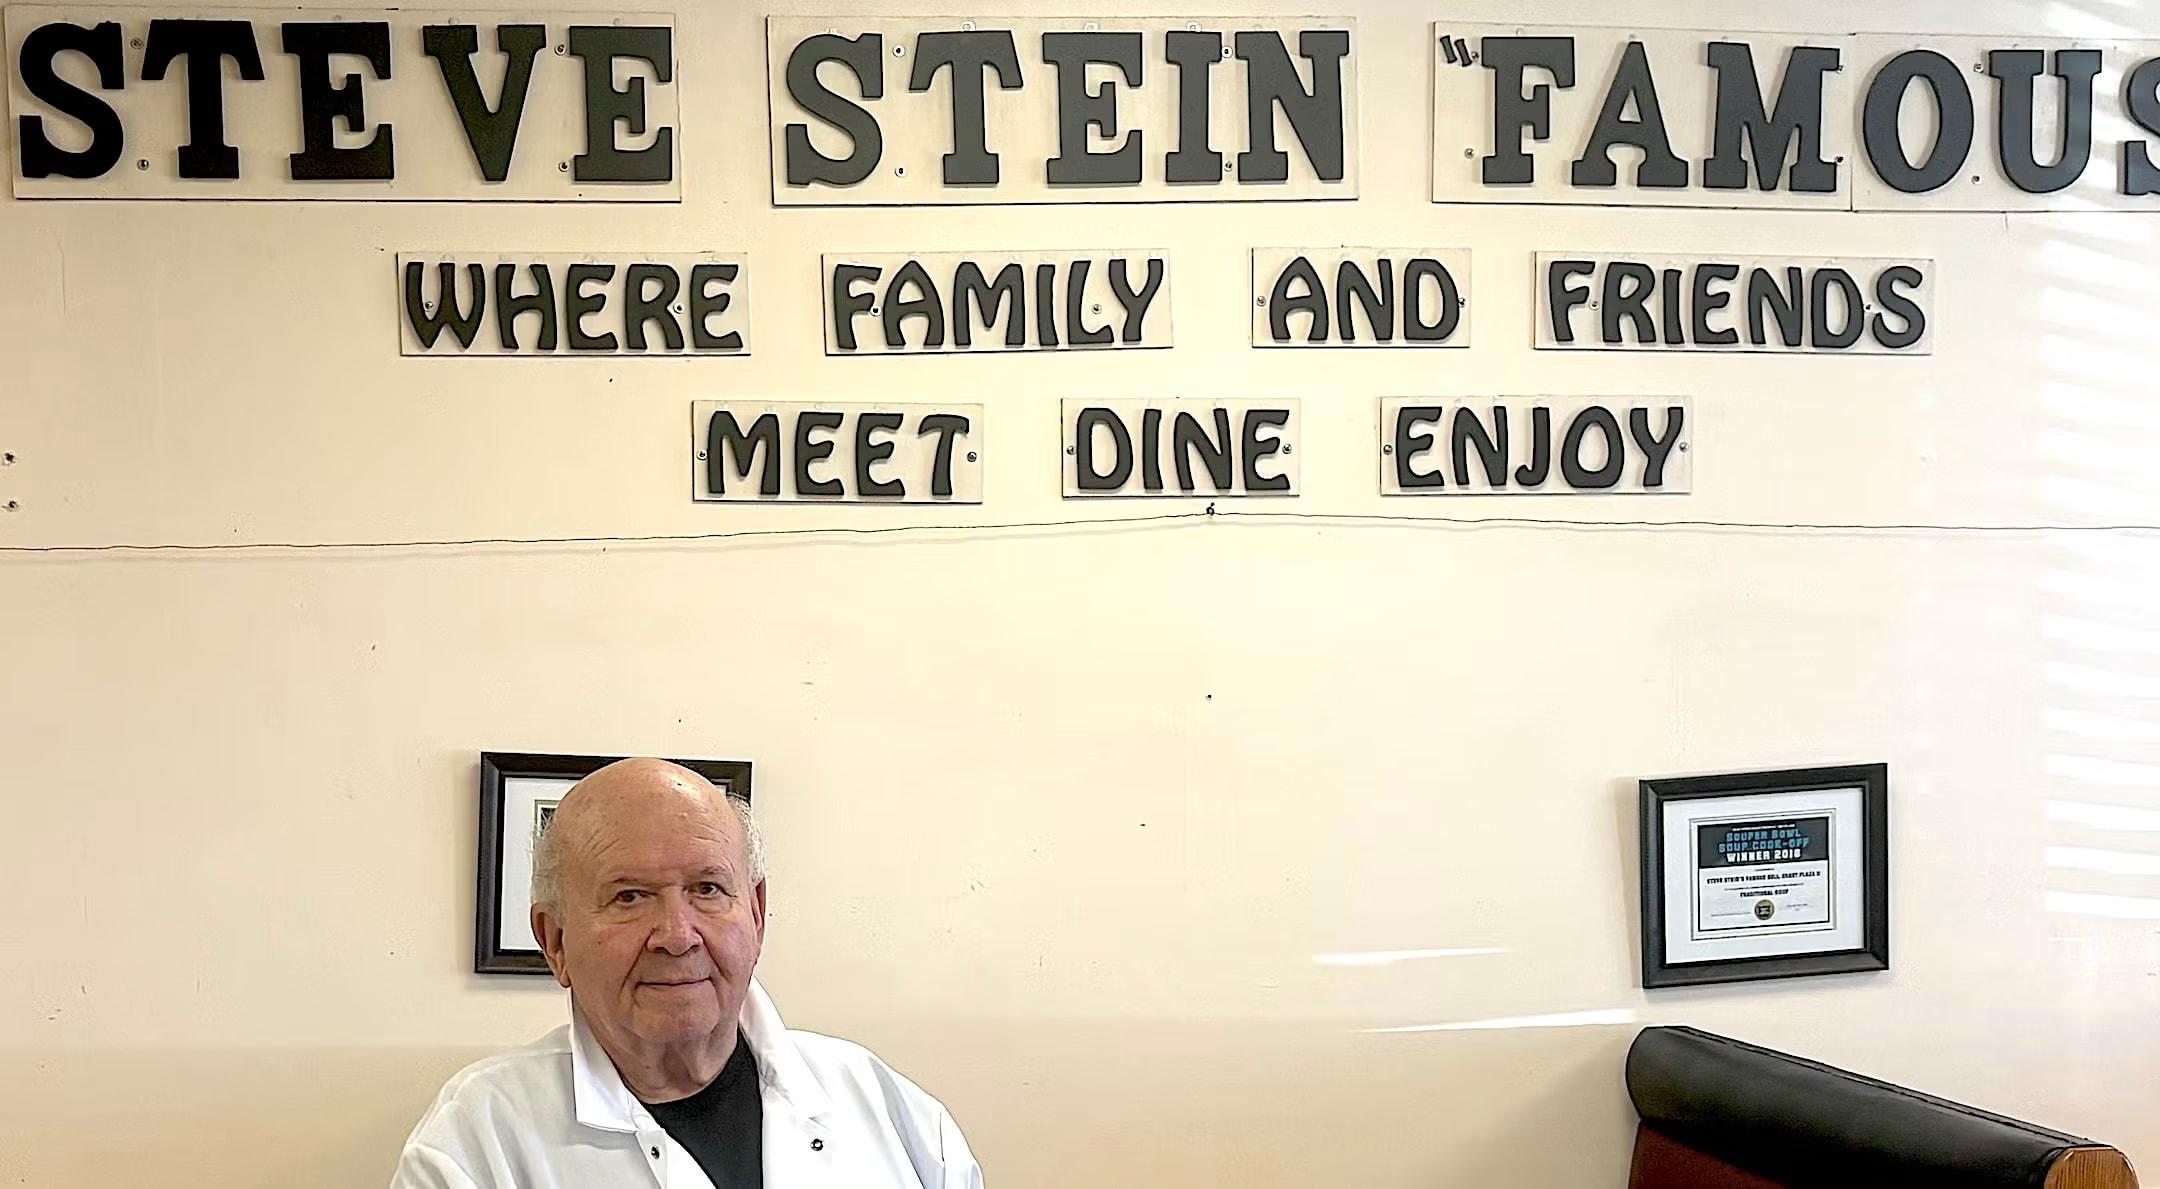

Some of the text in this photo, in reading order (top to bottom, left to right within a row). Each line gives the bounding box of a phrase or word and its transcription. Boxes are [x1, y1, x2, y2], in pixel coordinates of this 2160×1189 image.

[18, 20, 673, 184] STEVE
[785, 31, 1350, 186] STEIN
[404, 256, 1926, 351] WHERE FAMILY AND FRIENDS
[706, 405, 1684, 497] MEET DINE ENJOY
[1719, 837, 1809, 853] SOUP COOK-OFF
[1726, 850, 1770, 863] WINNER
[1771, 829, 1801, 839] BOWL
